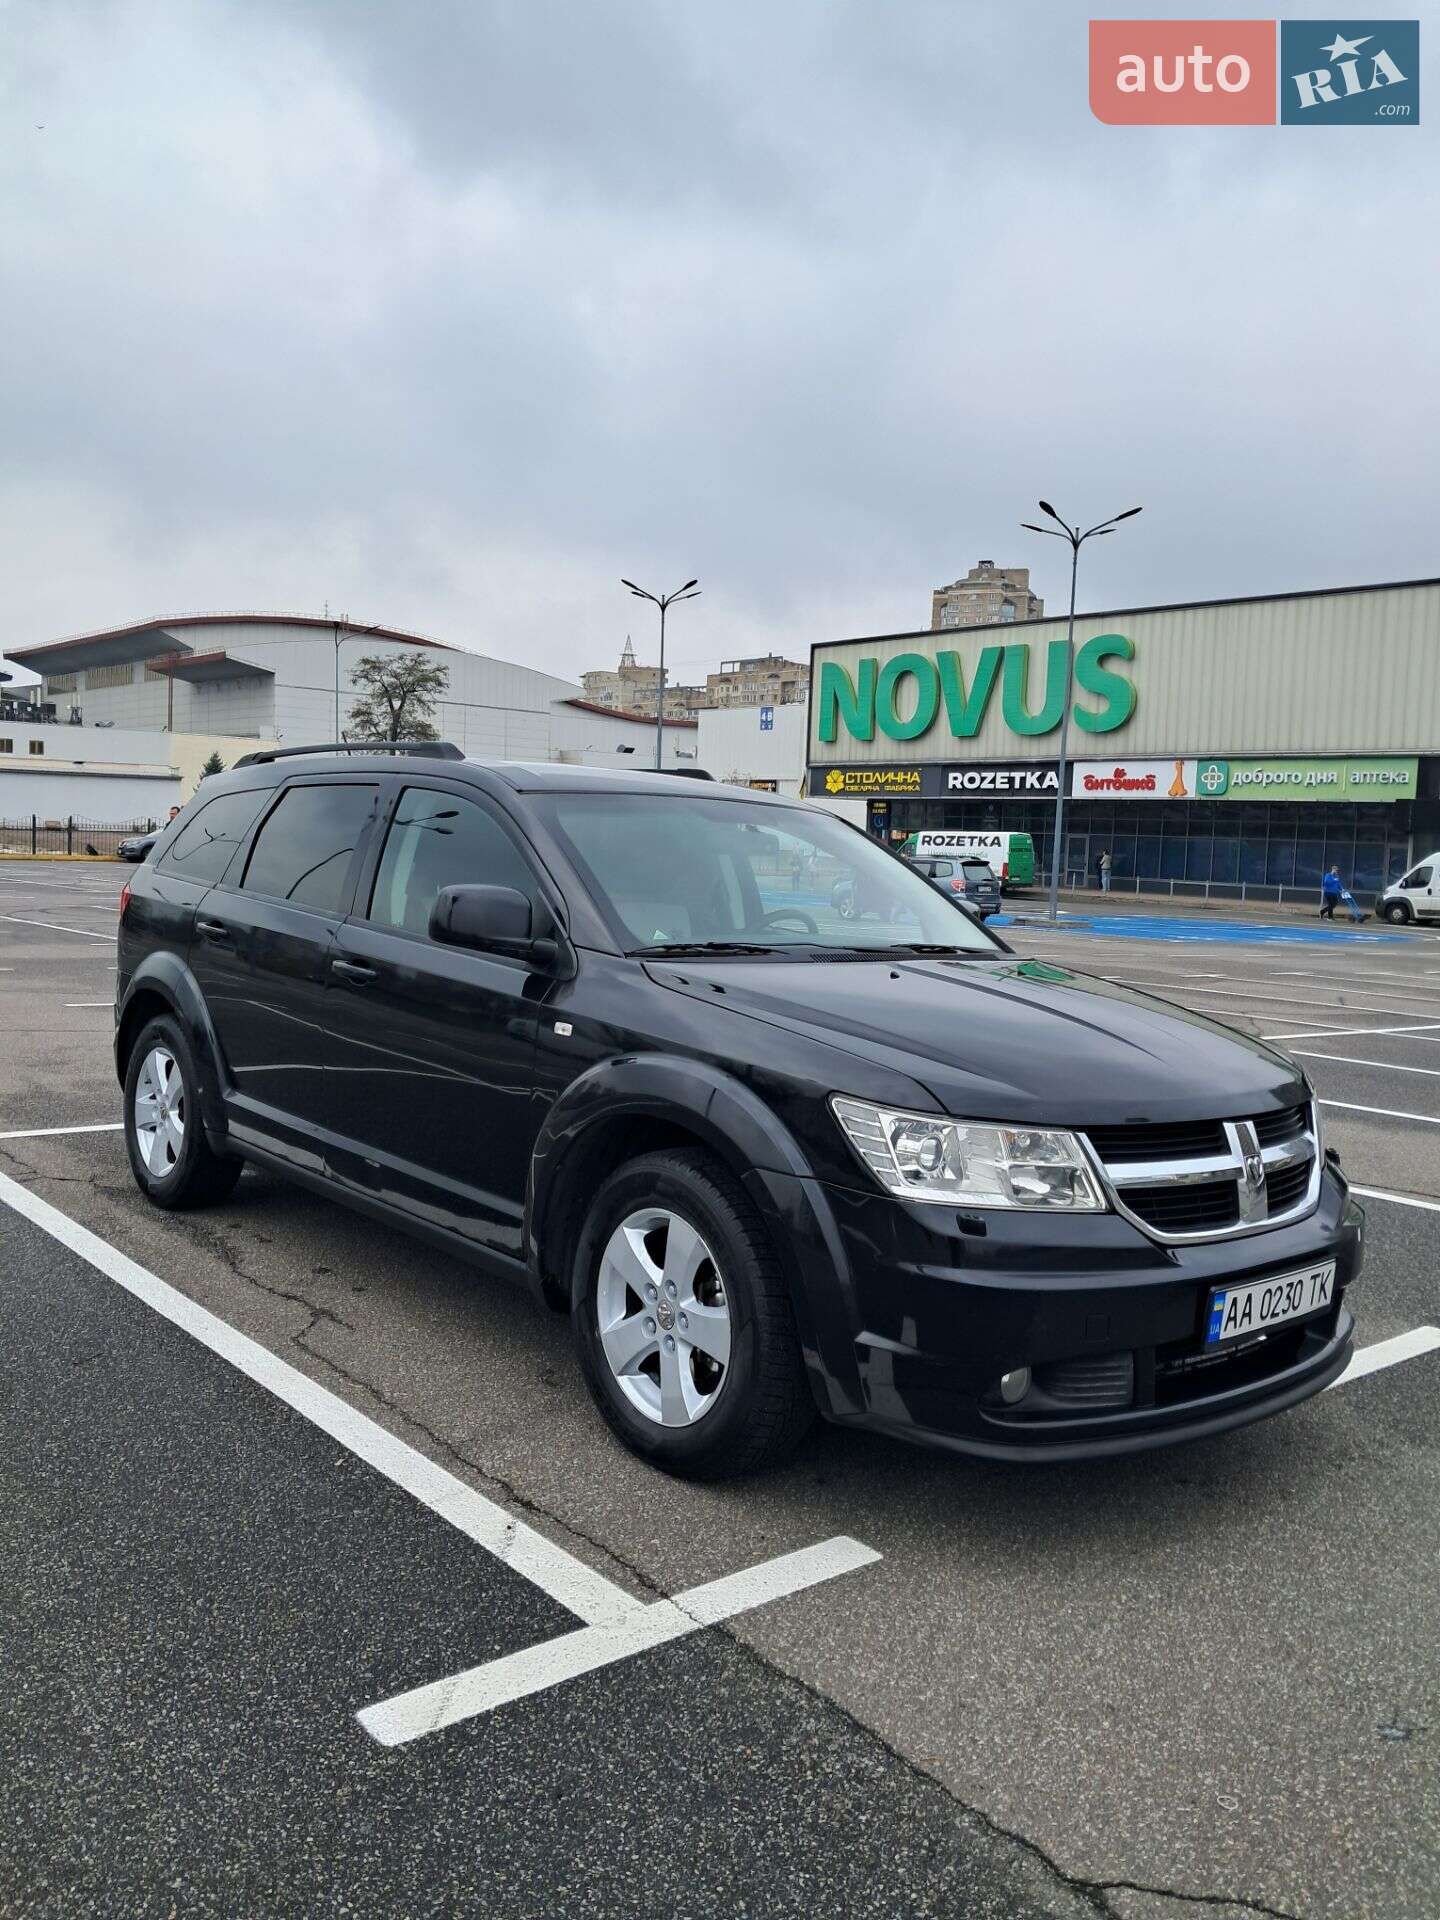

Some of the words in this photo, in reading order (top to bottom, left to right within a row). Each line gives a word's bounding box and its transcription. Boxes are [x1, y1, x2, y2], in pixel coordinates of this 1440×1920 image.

[818, 634, 1137, 742] NOVUS
[846, 772, 920, 784] СТОЛИЧНА
[948, 771, 1059, 790] ROZETKA
[1232, 769, 1301, 788] доброго
[1305, 771, 1337, 787] дня
[1350, 770, 1408, 785] аптека
[921, 835, 1002, 848] ROZETKA
[1224, 1293, 1253, 1332] AA
[1260, 1279, 1304, 1321] 0230
[1309, 1269, 1332, 1306] TK
